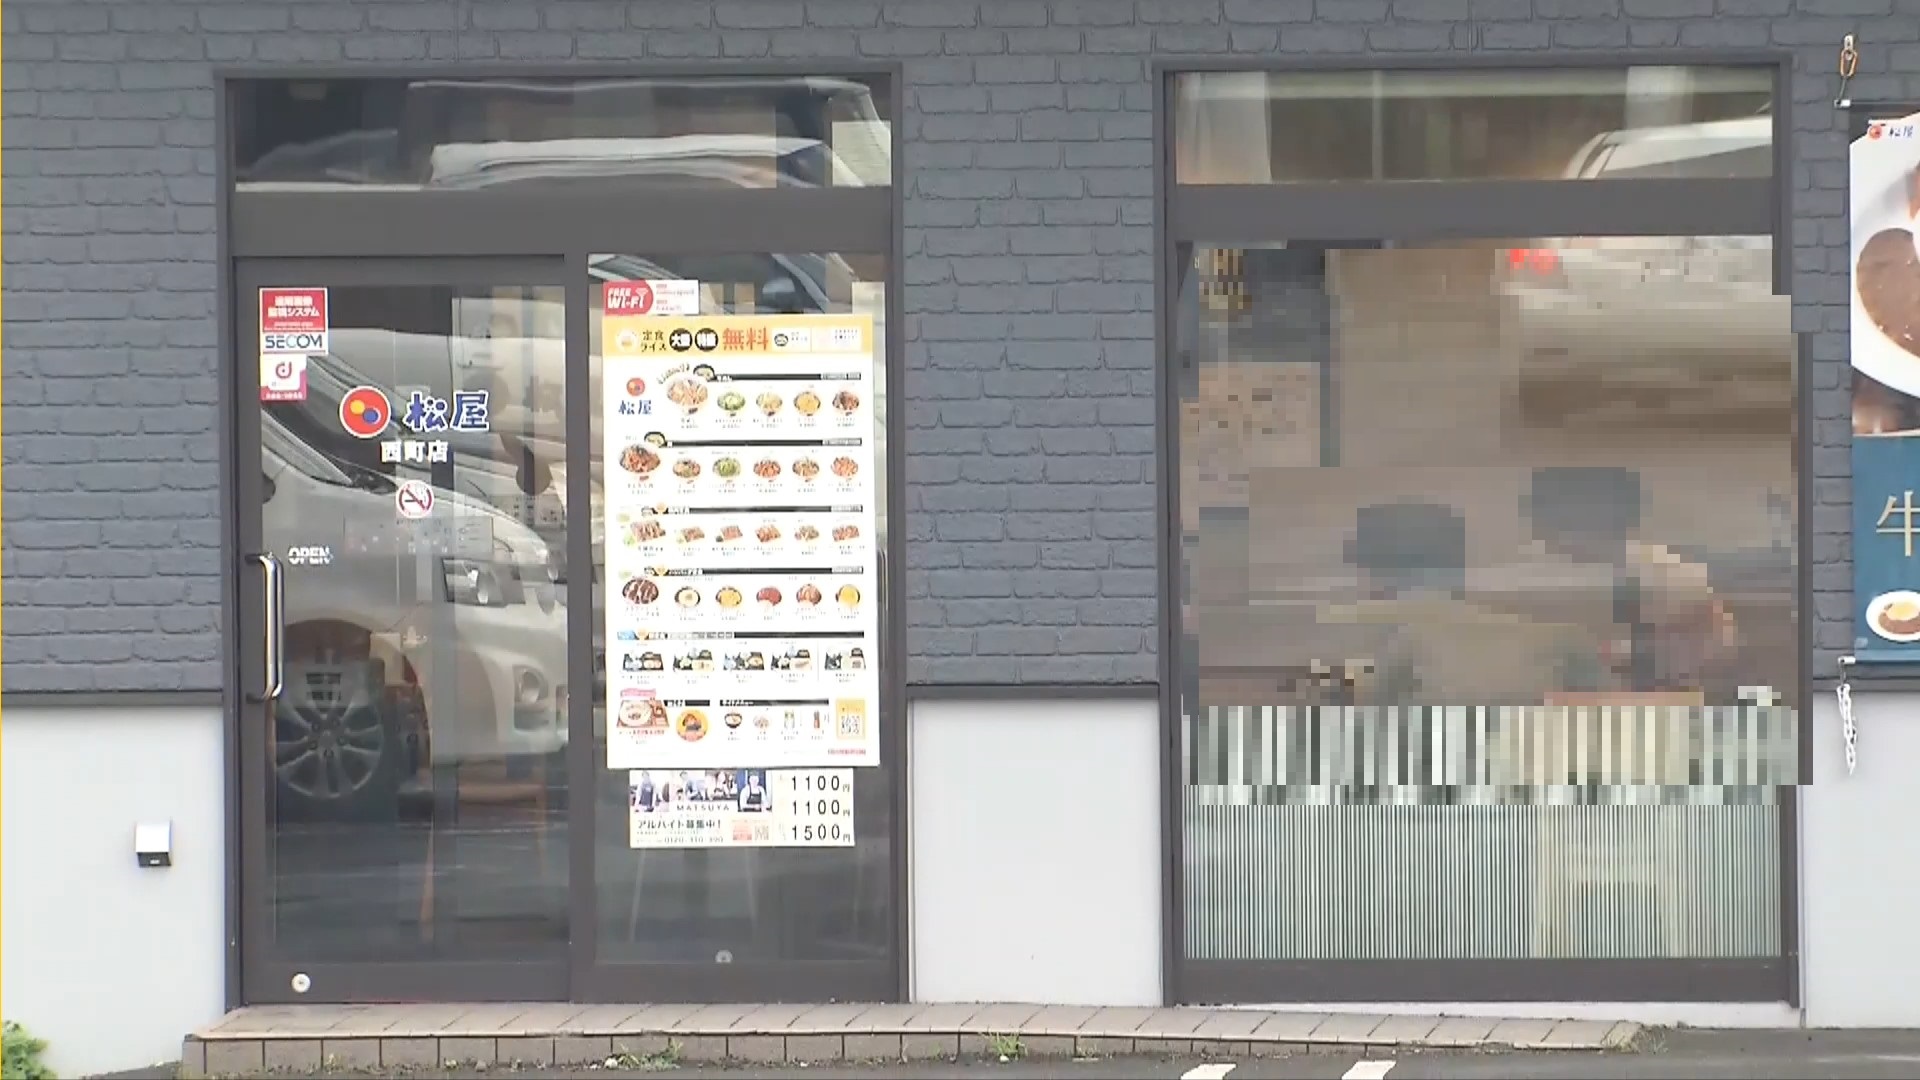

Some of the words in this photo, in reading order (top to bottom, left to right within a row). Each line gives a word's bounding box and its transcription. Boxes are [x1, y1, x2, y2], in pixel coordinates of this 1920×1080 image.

[608, 287, 632, 297] FREE
[265, 334, 323, 349] SECOM
[640, 341, 667, 353] ライス
[723, 327, 768, 351] 無料
[404, 390, 489, 431] 松屋
[618, 399, 652, 415] 松屋
[381, 440, 449, 463] 西町店
[288, 546, 331, 565] OPEN
